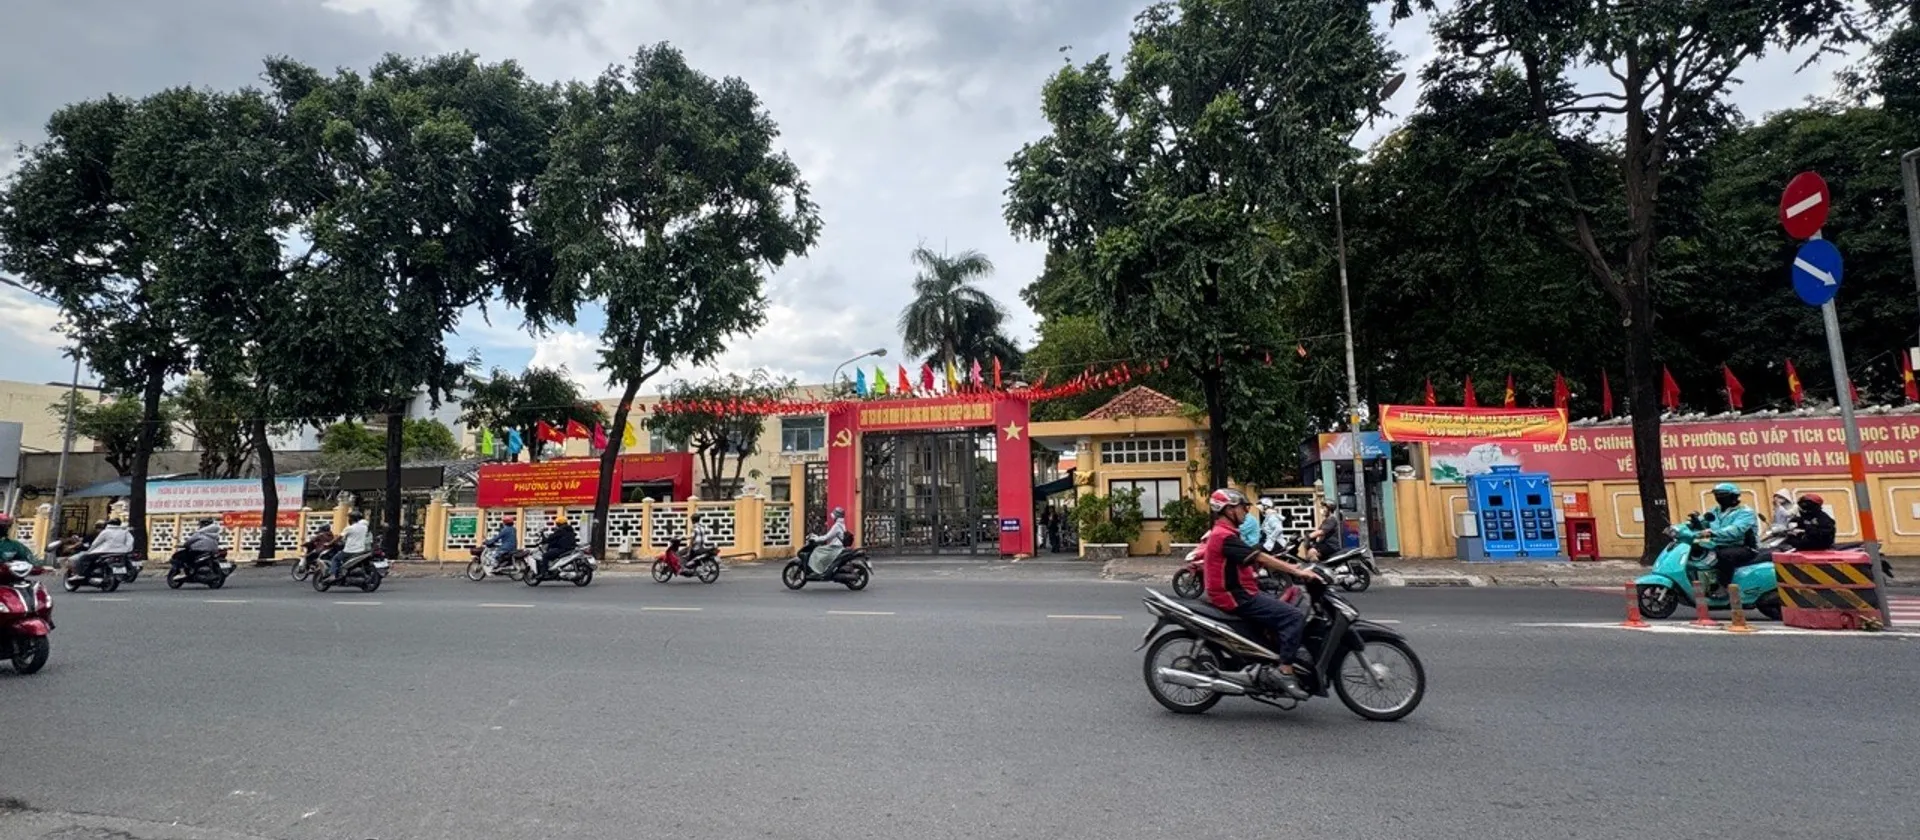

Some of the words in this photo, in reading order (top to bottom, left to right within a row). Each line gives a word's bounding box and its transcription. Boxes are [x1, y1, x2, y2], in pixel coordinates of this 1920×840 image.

[1570, 435, 1591, 454] BỘ,
[1595, 433, 1634, 450] CHÍNH
[1683, 428, 1736, 448] PHƯỜNG
[1739, 428, 1758, 445] GÒ
[1761, 424, 1788, 444] VẤP
[1792, 424, 1824, 443] TÍCH
[1859, 427, 1888, 444] HỌC
[1892, 423, 1920, 443] TẬP
[1616, 454, 1633, 472] VỀ
[1680, 455, 1698, 473] TỰ
[1700, 454, 1730, 472] LỰC,
[1732, 454, 1750, 471] TỰ
[1754, 450, 1800, 468] CƯỜNG
[1803, 449, 1822, 466] VÀ
[1864, 450, 1906, 468] VỌNG
[514, 480, 549, 491] PHƯỜNG
[551, 480, 562, 490] GÒ
[564, 479, 581, 489] VẤP
